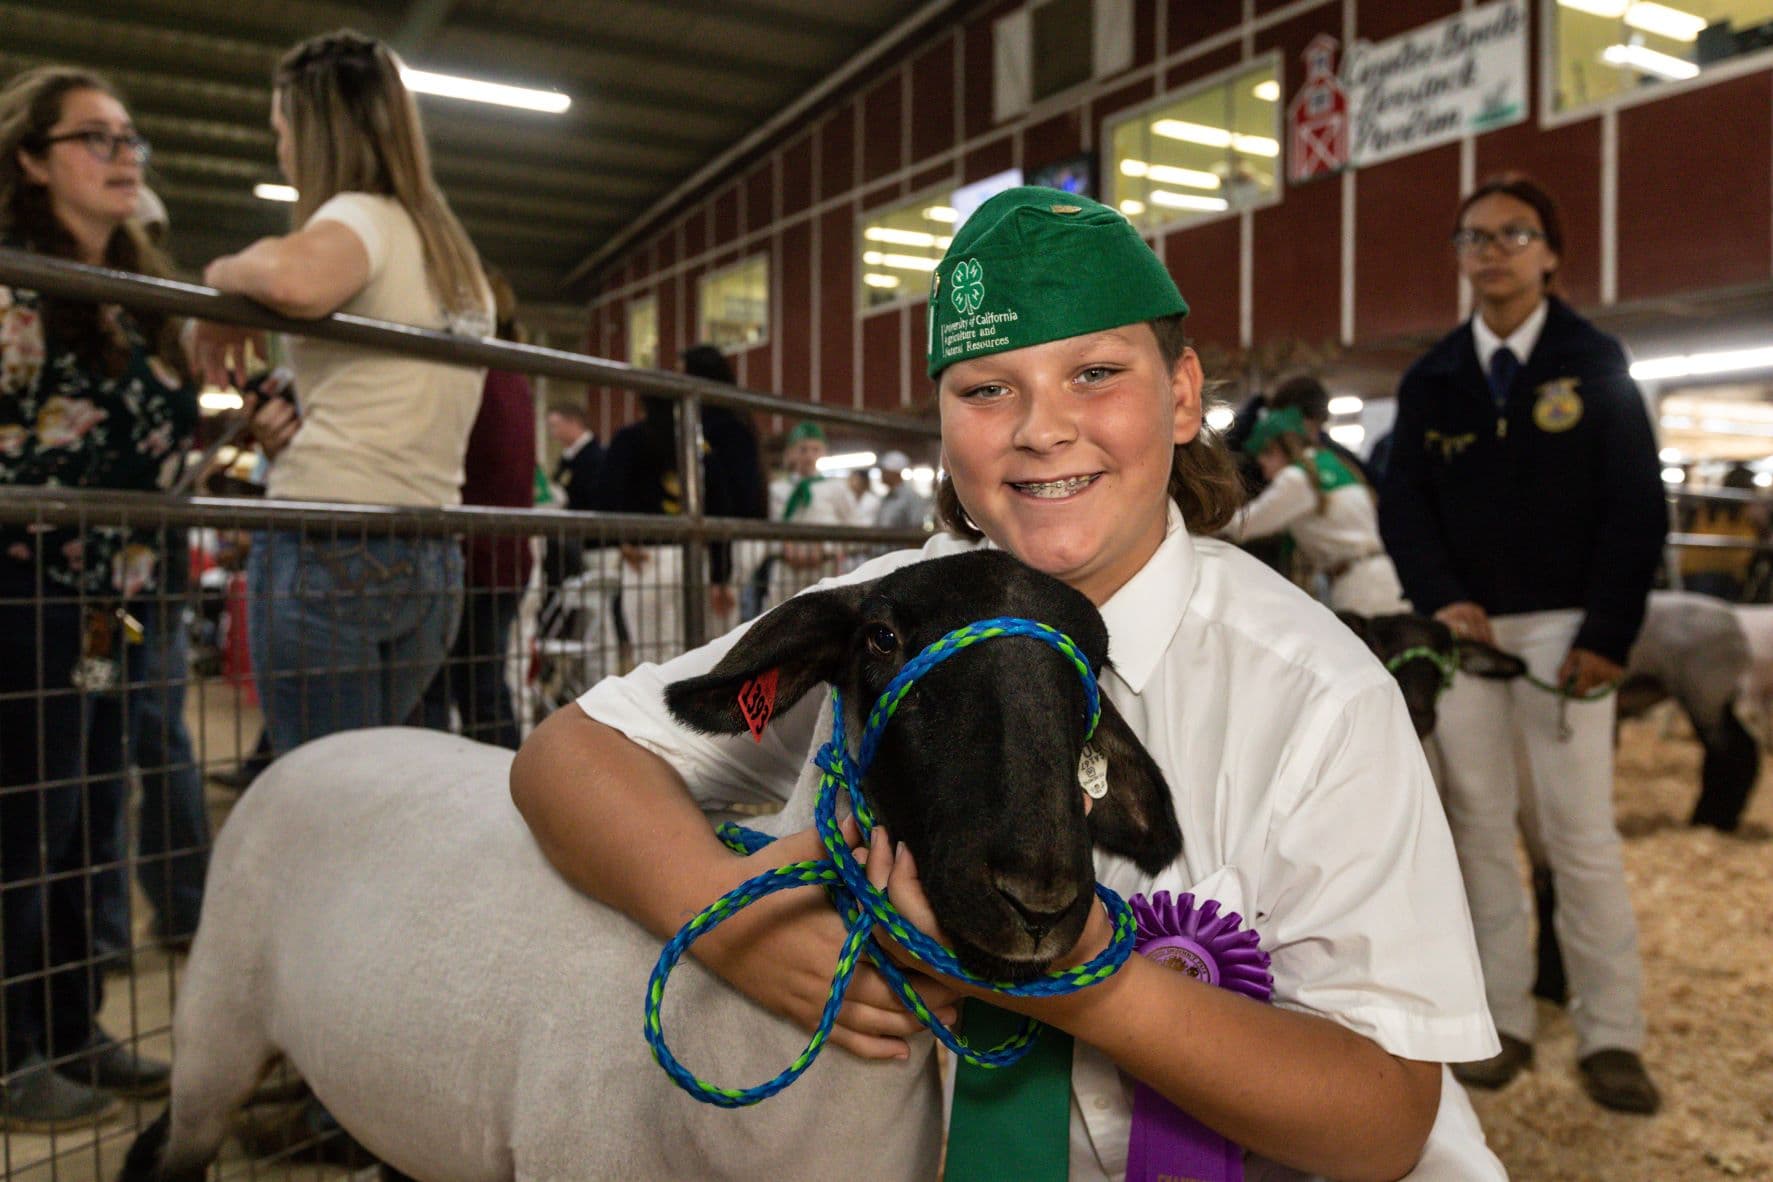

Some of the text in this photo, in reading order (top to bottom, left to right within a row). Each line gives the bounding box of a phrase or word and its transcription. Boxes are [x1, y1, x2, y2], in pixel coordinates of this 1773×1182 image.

[976, 309, 1018, 325] California
[980, 325, 996, 337] and
[966, 336, 1010, 351] Resources
